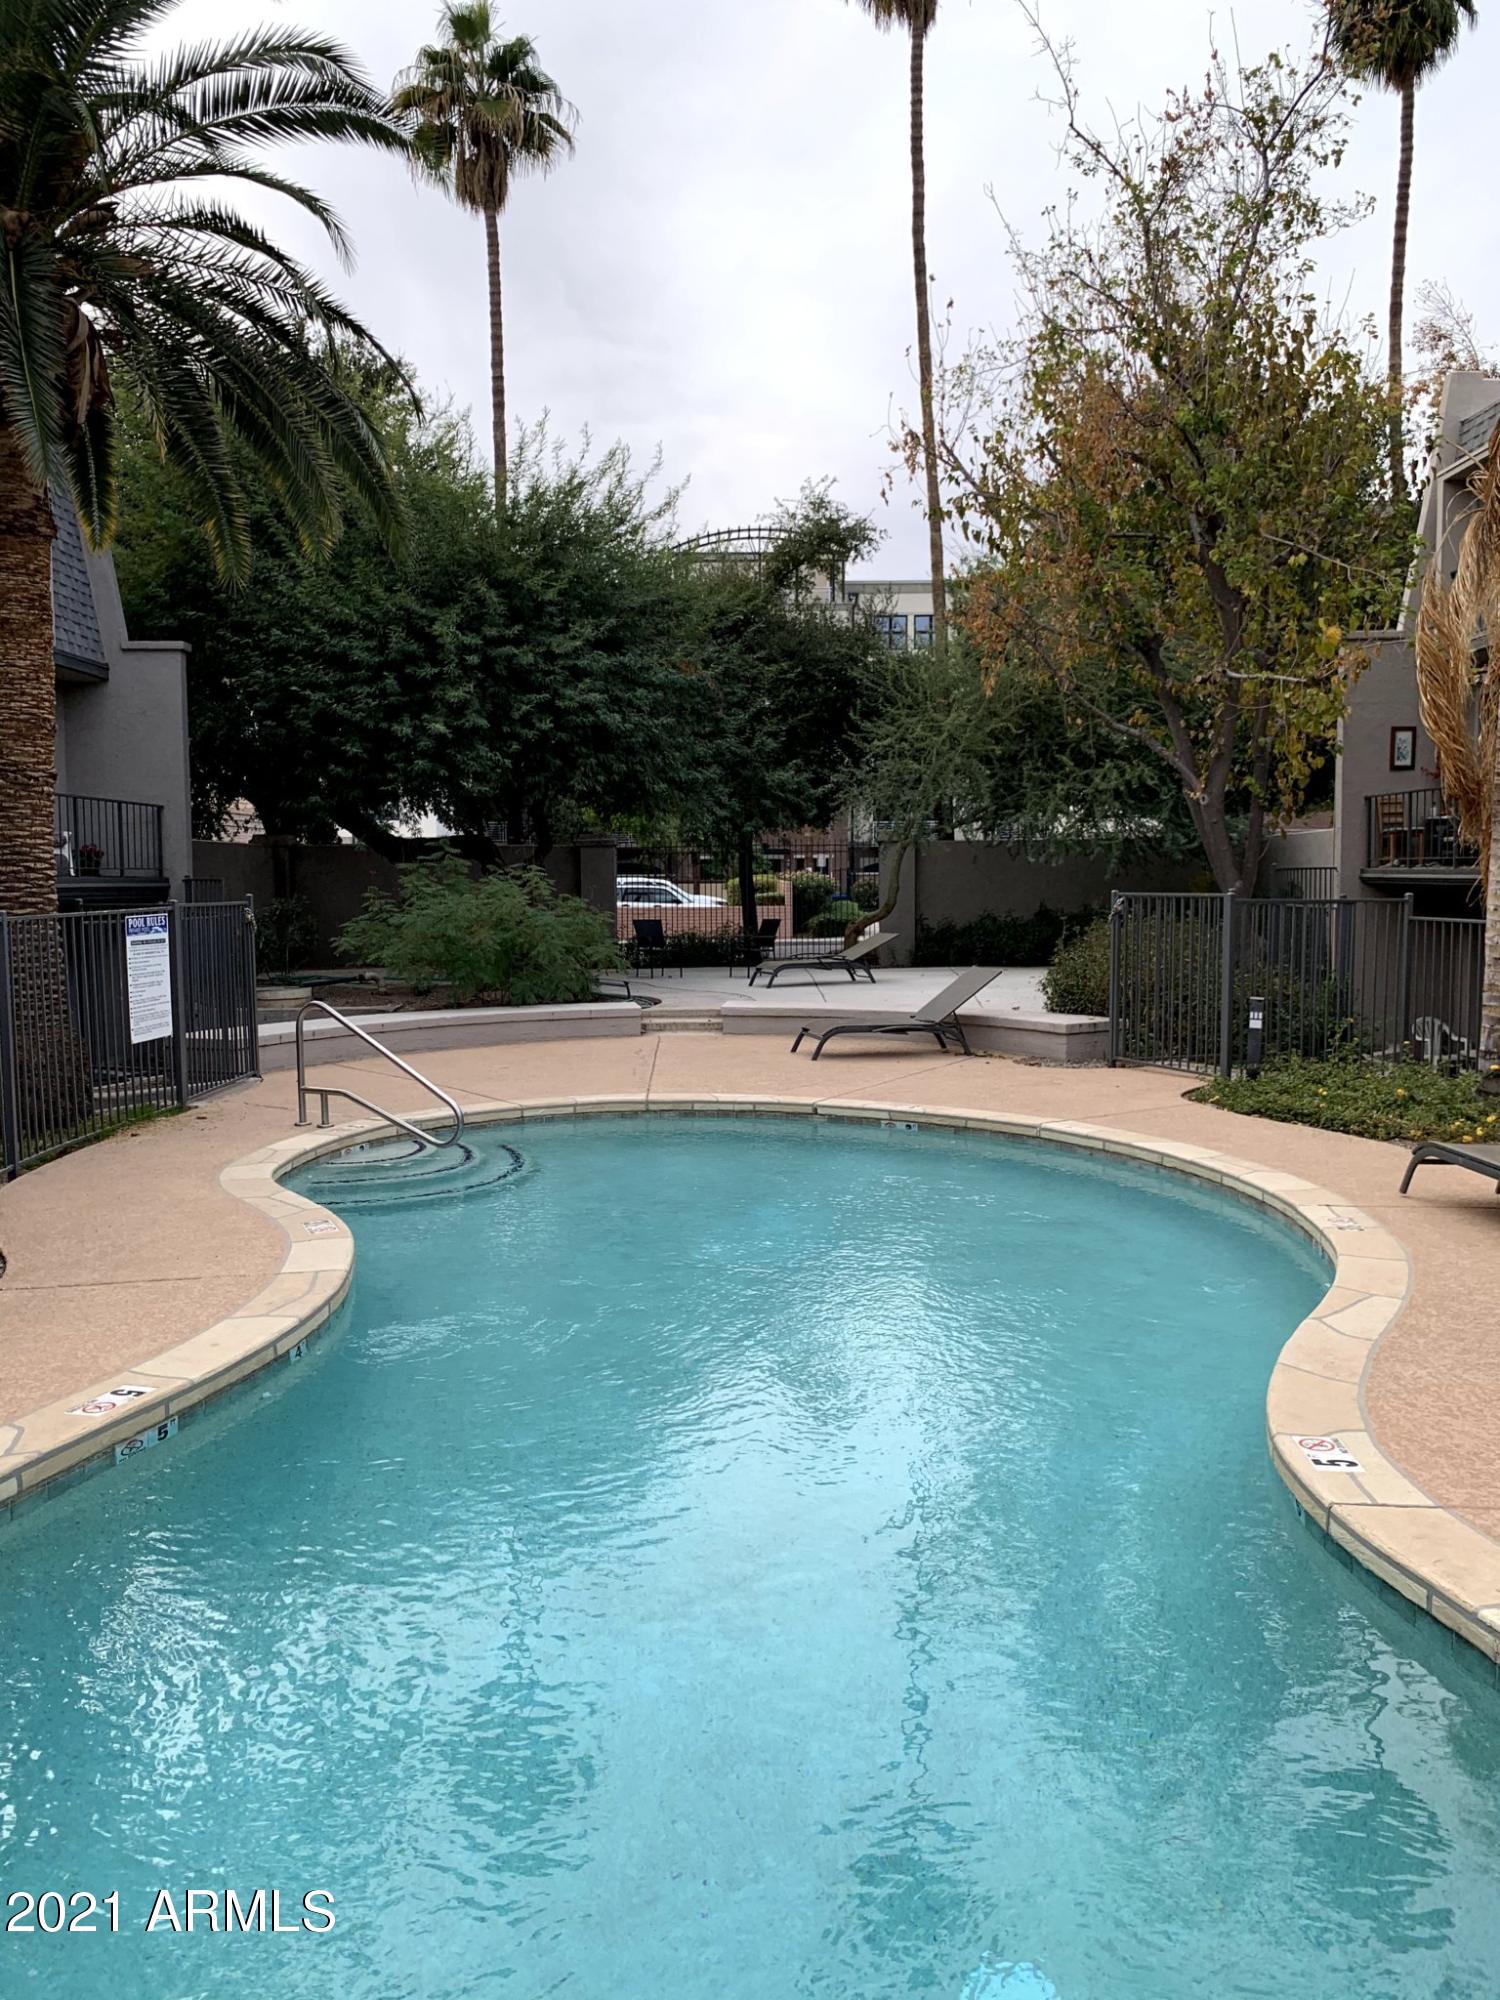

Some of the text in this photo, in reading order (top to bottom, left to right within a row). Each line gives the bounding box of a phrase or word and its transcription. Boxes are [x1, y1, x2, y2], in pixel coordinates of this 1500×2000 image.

[128, 916, 166, 928] POOL RULES
[157, 1422, 169, 1441] 5
[1311, 1458, 1359, 1467] 5
